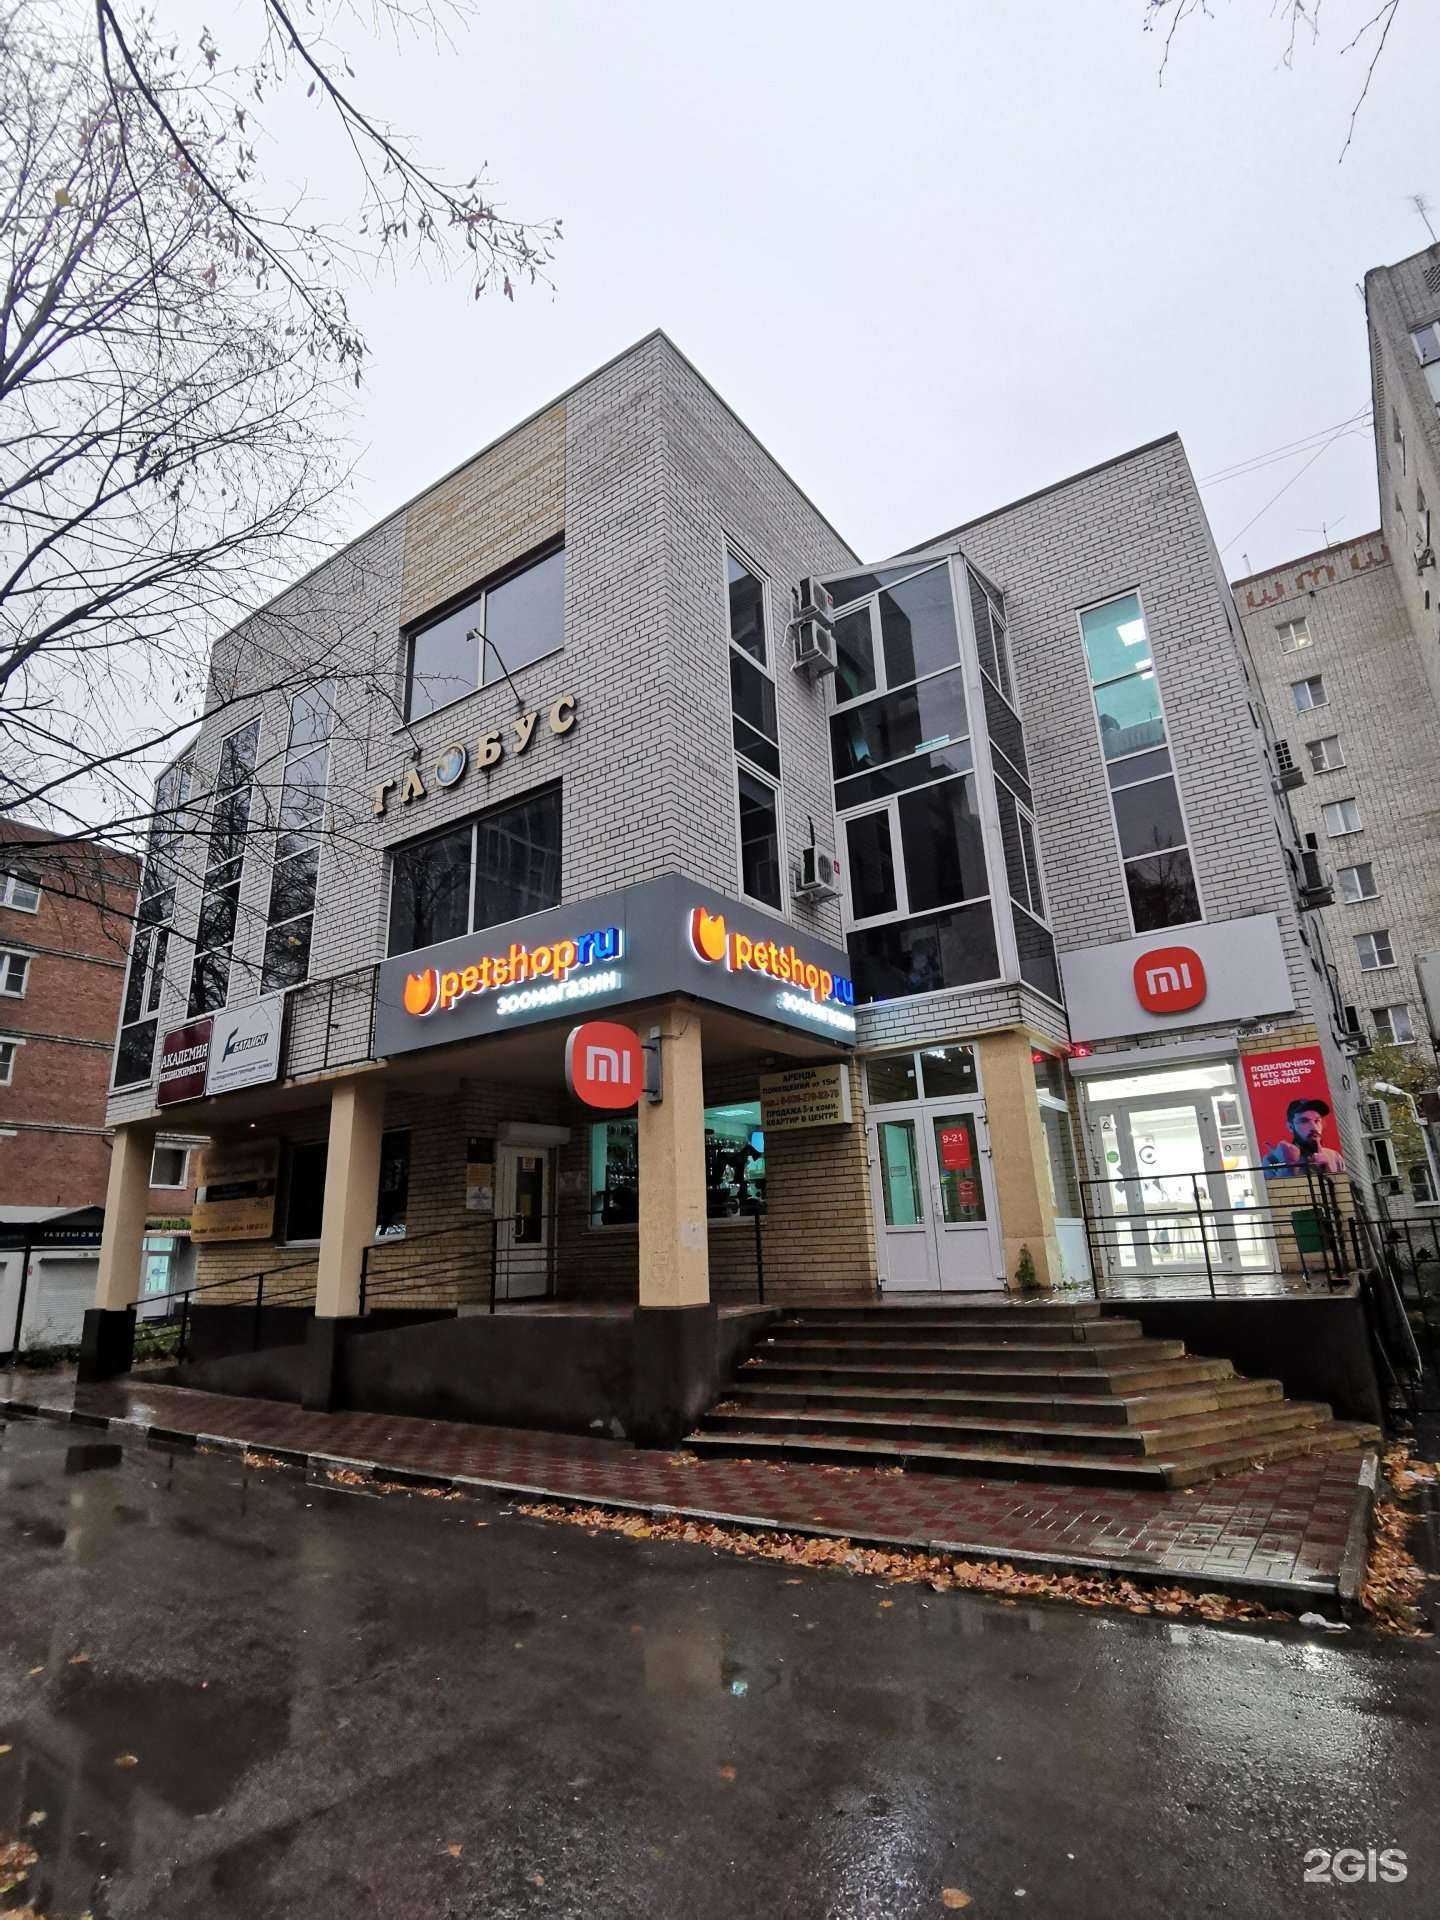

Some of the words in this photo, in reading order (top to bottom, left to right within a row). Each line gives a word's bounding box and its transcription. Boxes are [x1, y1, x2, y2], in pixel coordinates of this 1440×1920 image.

[372, 694, 577, 816] ГЛОБУС
[160, 1043, 208, 1069] АКАДЕМИЯ
[1250, 1058, 1316, 1073] ПОДКЛЮЧИСЬ
[1260, 1071, 1279, 1080] МТС
[1280, 1067, 1311, 1078] ЗДЕСЬ
[1262, 1076, 1301, 1087] СЕЙЧАС!
[942, 1133, 963, 1144] 9-21
